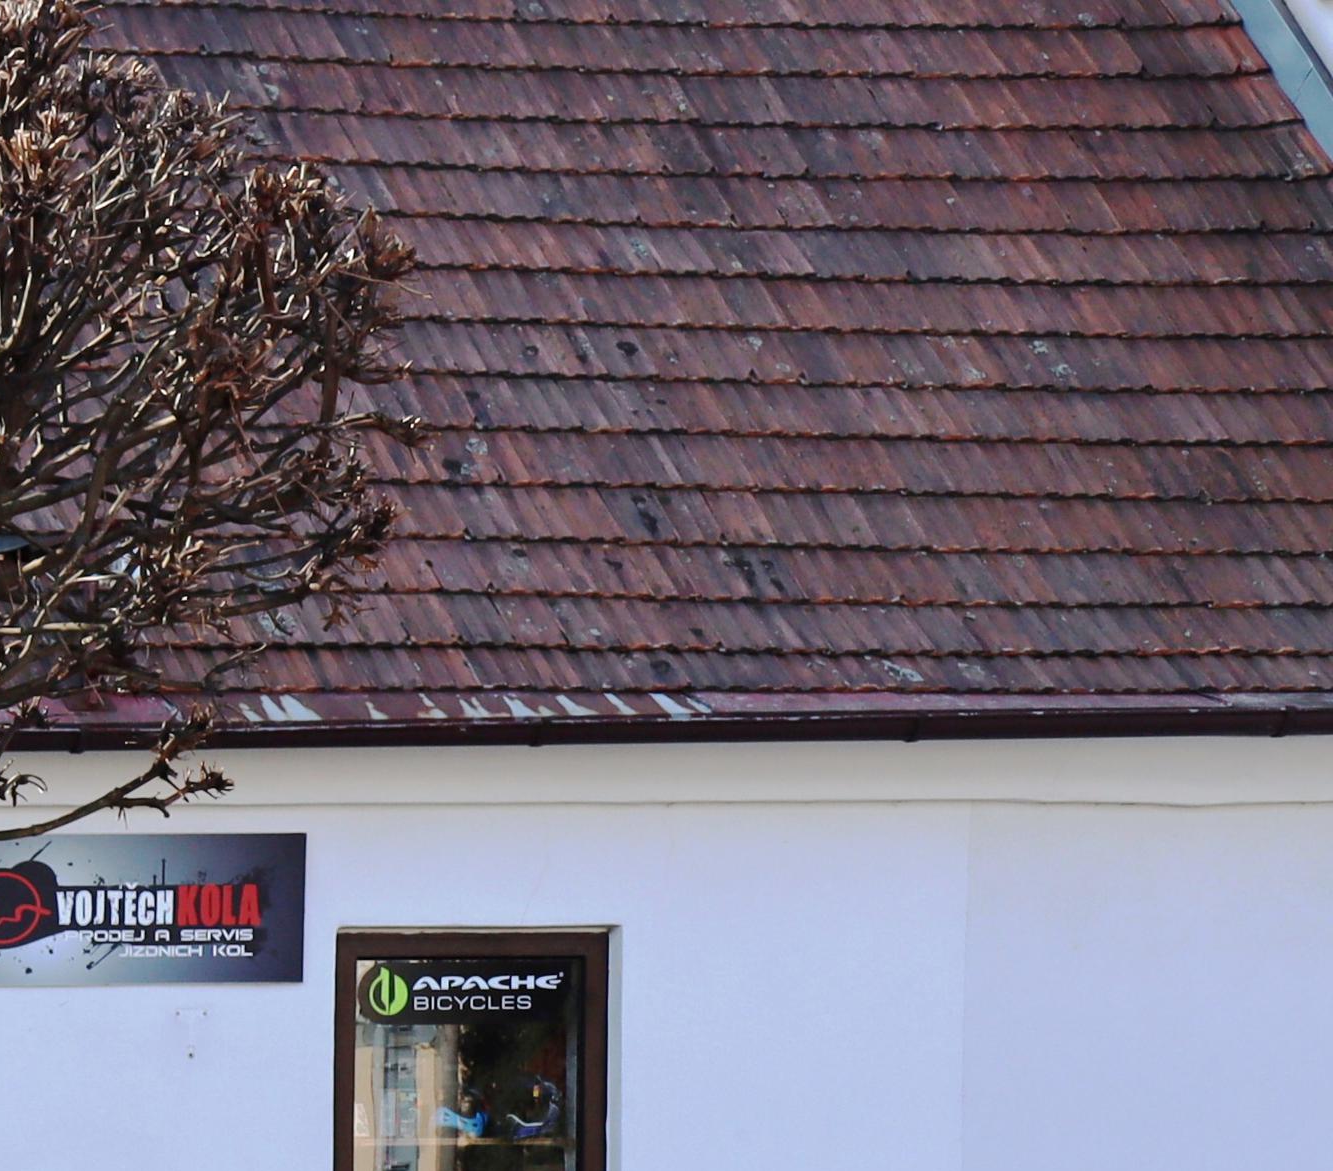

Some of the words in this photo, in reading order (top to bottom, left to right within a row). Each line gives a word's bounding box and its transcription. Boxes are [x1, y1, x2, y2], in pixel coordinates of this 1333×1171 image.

[56, 882, 174, 926] VOJTĚCH
[177, 883, 262, 927] KOLA
[65, 929, 145, 942] PRODEJ
[154, 929, 170, 942] A
[180, 928, 254, 942] SERVIS
[212, 944, 254, 957] KOL
[412, 974, 562, 991] APACHE
[413, 995, 532, 1011] BICYCLES
